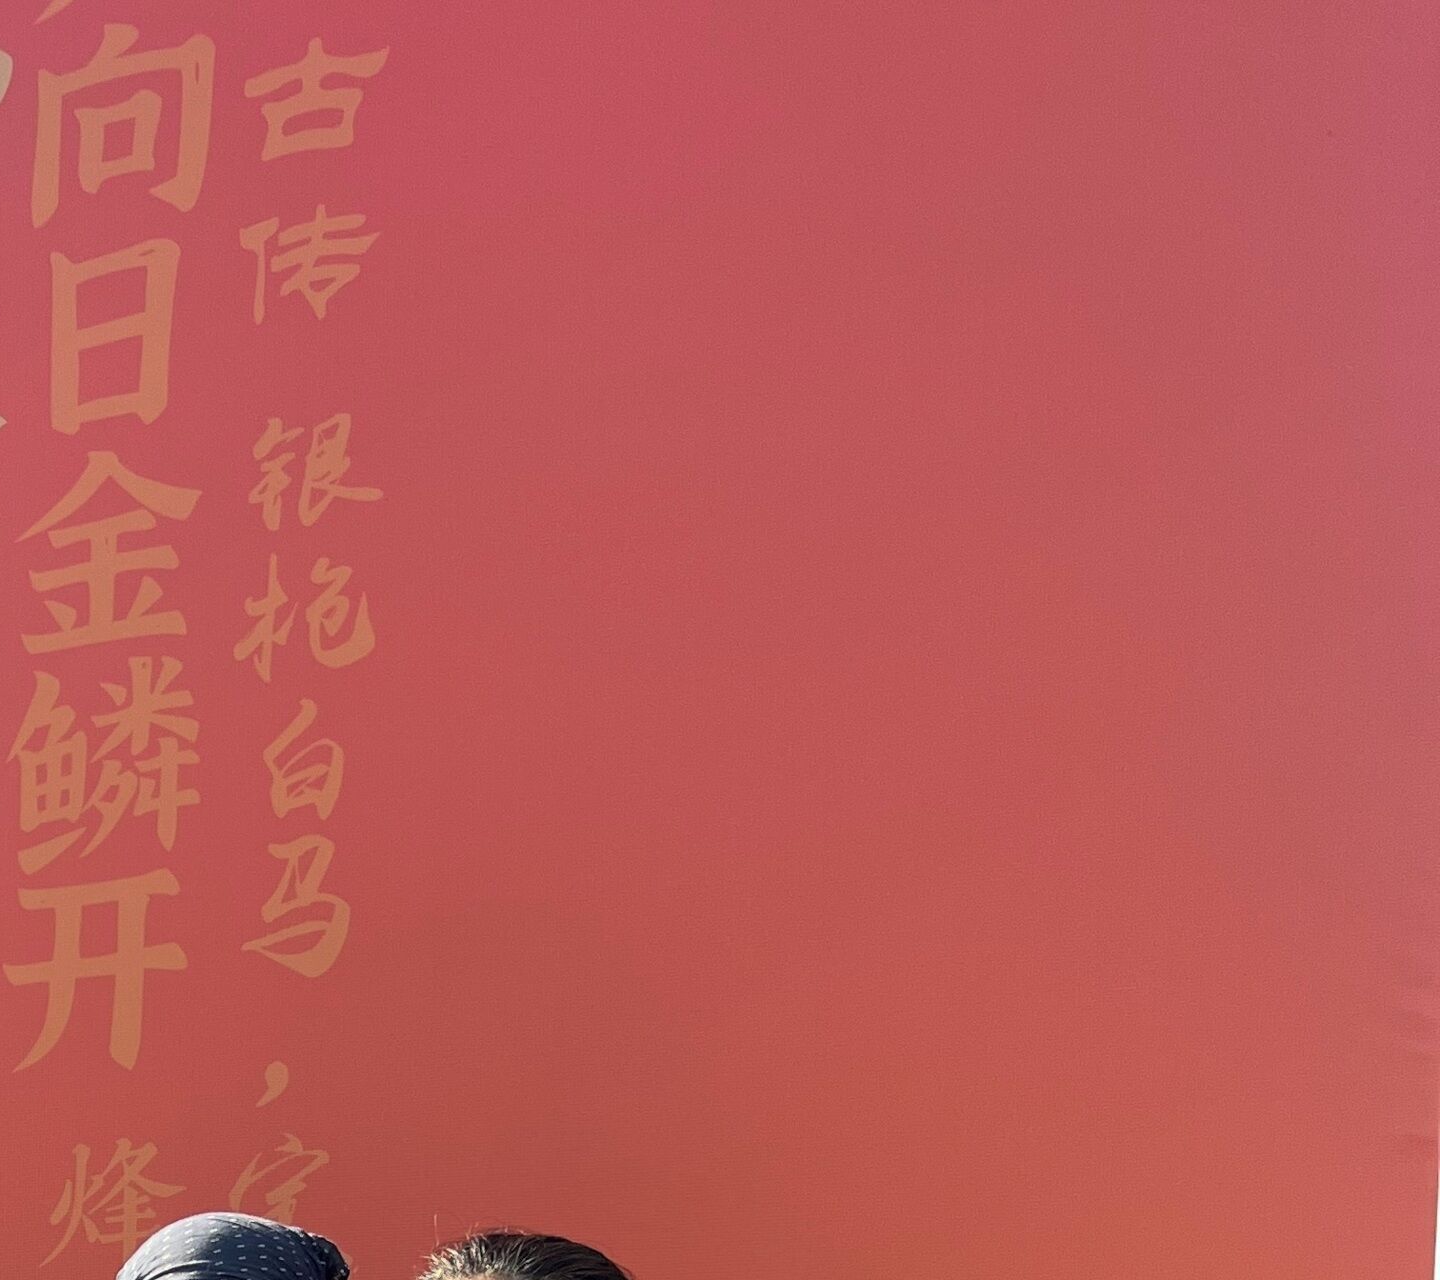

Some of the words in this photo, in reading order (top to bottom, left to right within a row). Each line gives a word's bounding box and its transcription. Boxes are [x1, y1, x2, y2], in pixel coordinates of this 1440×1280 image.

[0, 0, 218, 1073] 向日金鳞开
